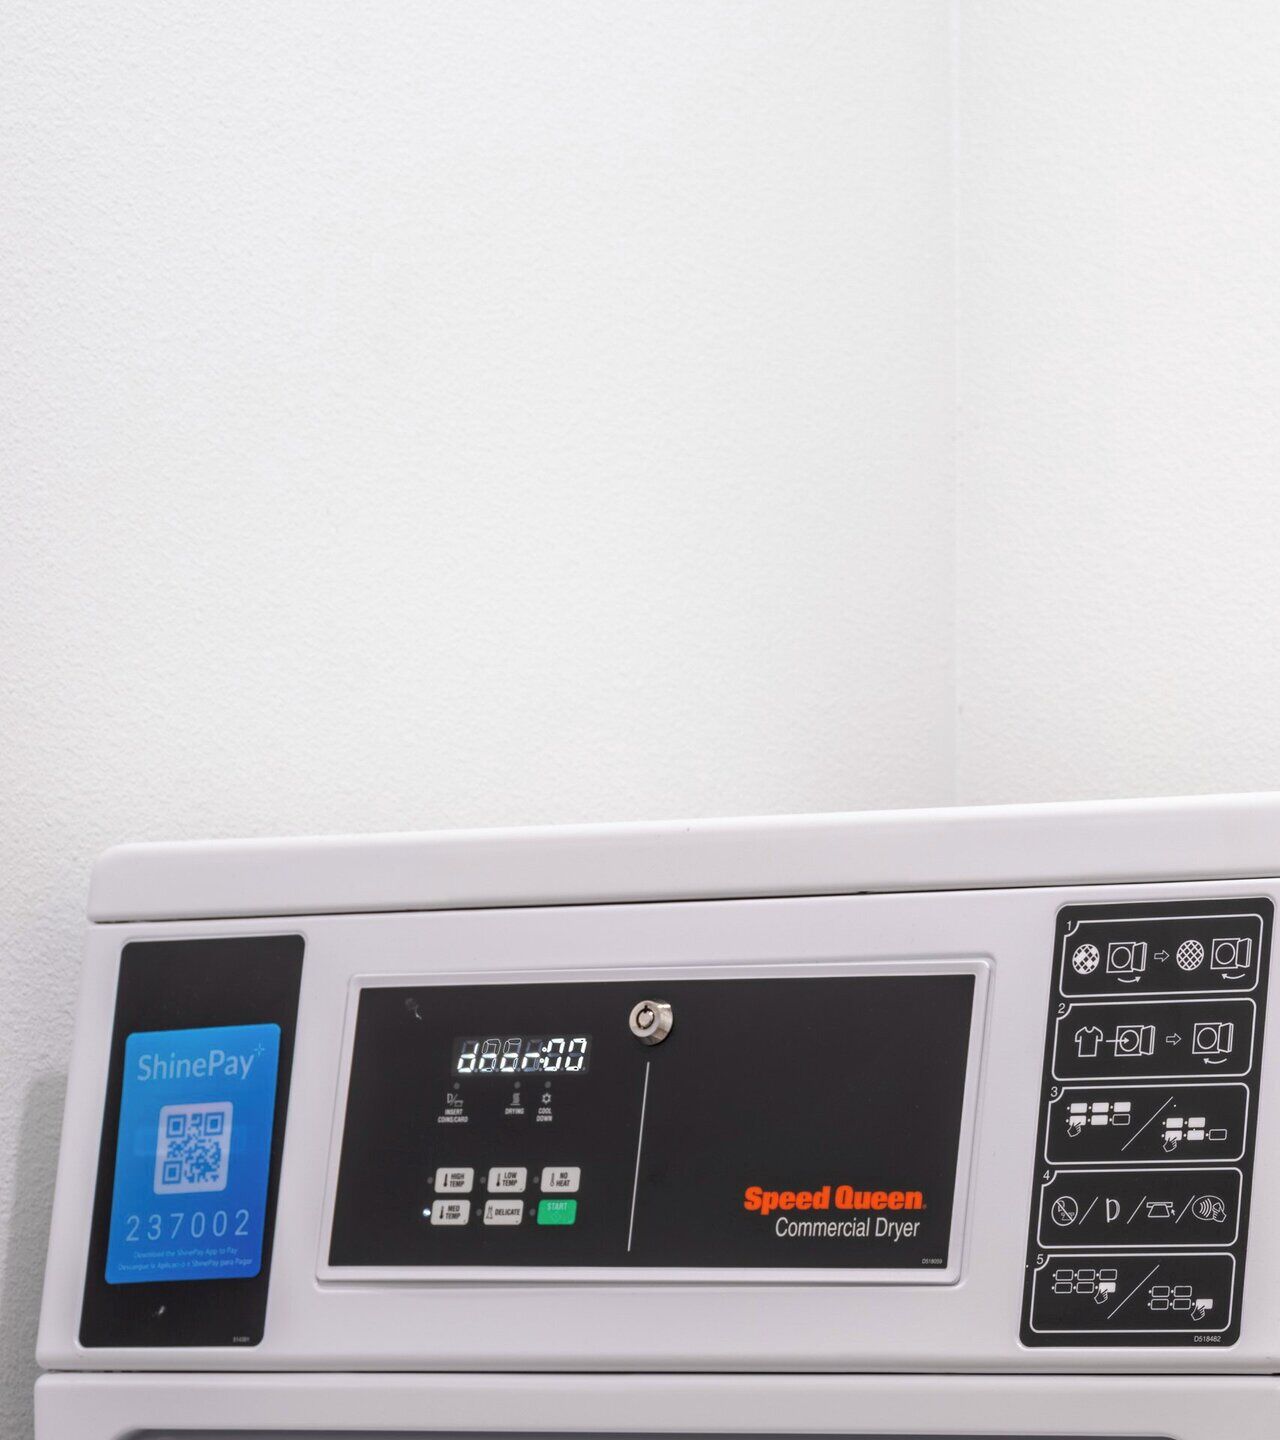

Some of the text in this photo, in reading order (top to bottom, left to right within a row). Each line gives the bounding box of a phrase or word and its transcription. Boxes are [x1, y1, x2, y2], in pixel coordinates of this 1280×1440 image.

[1066, 920, 1073, 931] 1
[1057, 1003, 1066, 1014] 2
[137, 1049, 254, 1081] ShinePay
[1050, 1086, 1058, 1097] 3
[504, 1107, 525, 1115] DRYING
[503, 1171, 518, 1179] LOW
[559, 1171, 569, 1179] NO
[1042, 1170, 1050, 1181] 4
[502, 1179, 518, 1187] TEMP
[555, 1179, 571, 1187] HEAT
[743, 1185, 923, 1216] Speed Queen
[546, 1202, 568, 1211] START
[445, 1212, 461, 1220] TEMP
[494, 1208, 521, 1217] DELICATE
[126, 1208, 250, 1242] 237002
[775, 1216, 920, 1242] Commercial Dryer
[1036, 1253, 1044, 1265] 5
